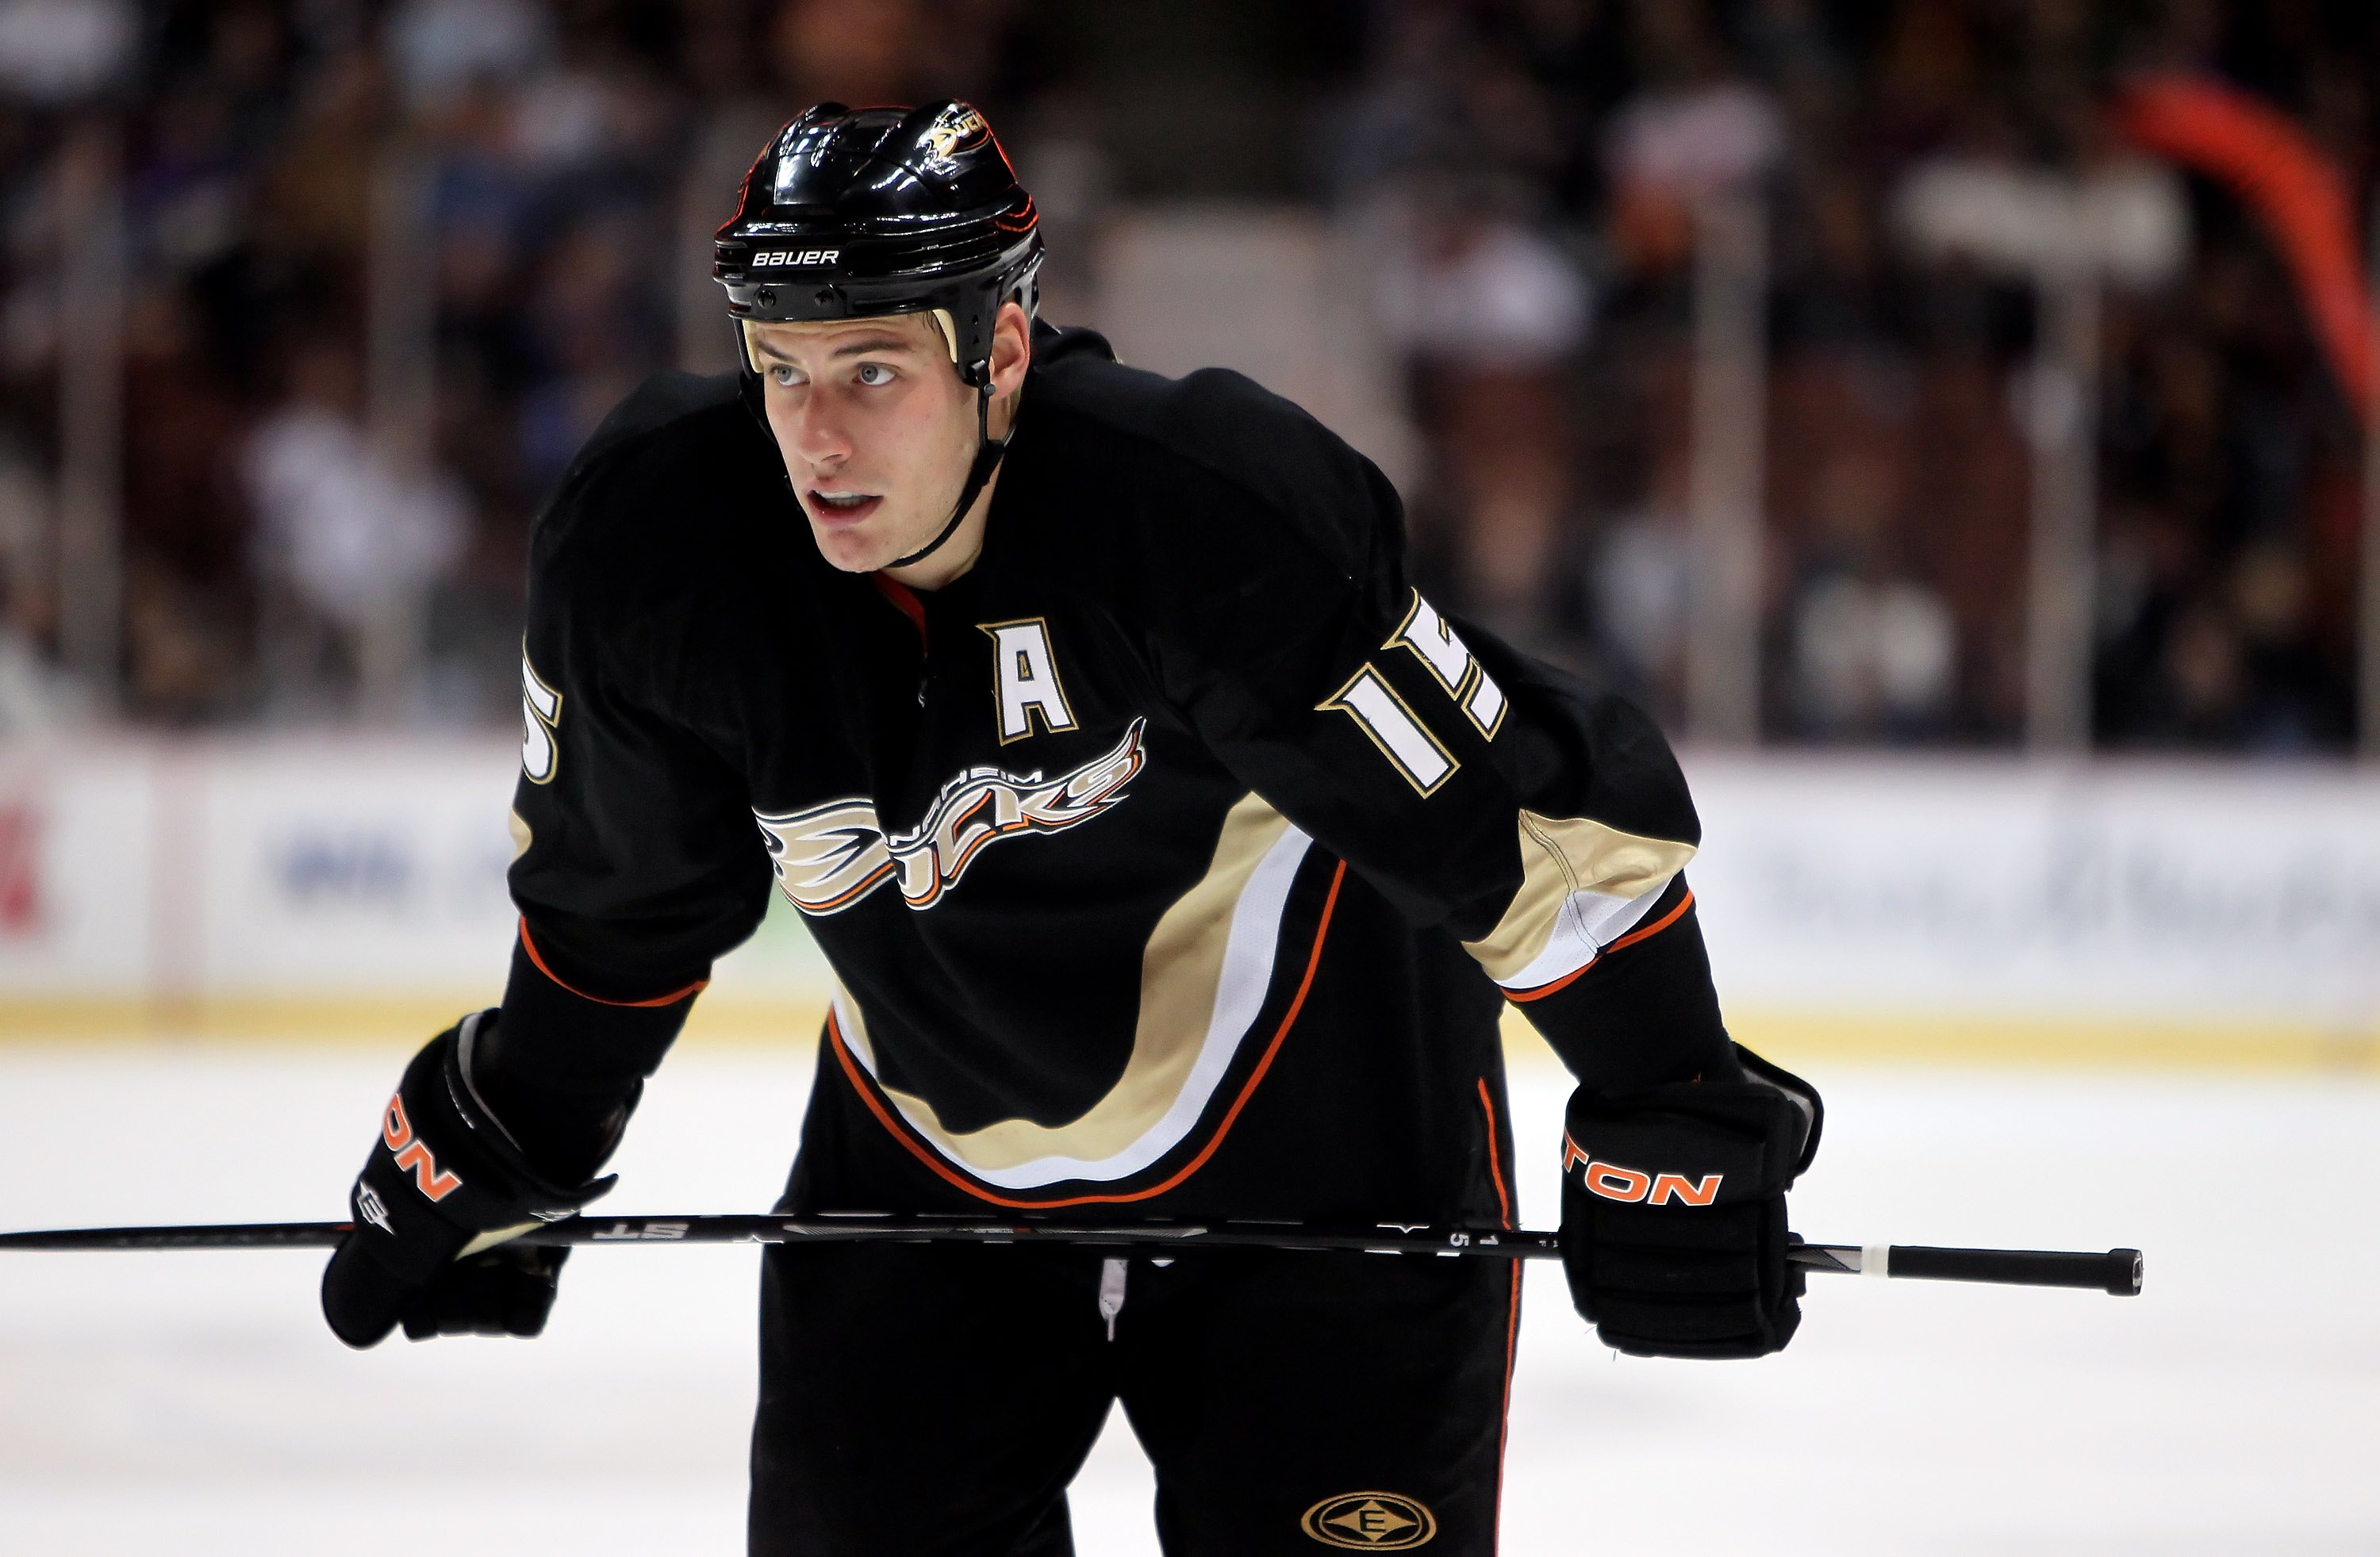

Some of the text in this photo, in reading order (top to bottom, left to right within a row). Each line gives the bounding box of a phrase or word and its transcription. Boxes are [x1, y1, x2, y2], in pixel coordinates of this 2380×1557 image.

[751, 250, 840, 267] BAUER
[521, 631, 564, 785] 5
[975, 616, 1080, 746] A
[1314, 585, 1508, 800] 15
[888, 766, 1042, 847] NAHEIM
[383, 1091, 463, 1203] ON
[1563, 1126, 1724, 1206] TON
